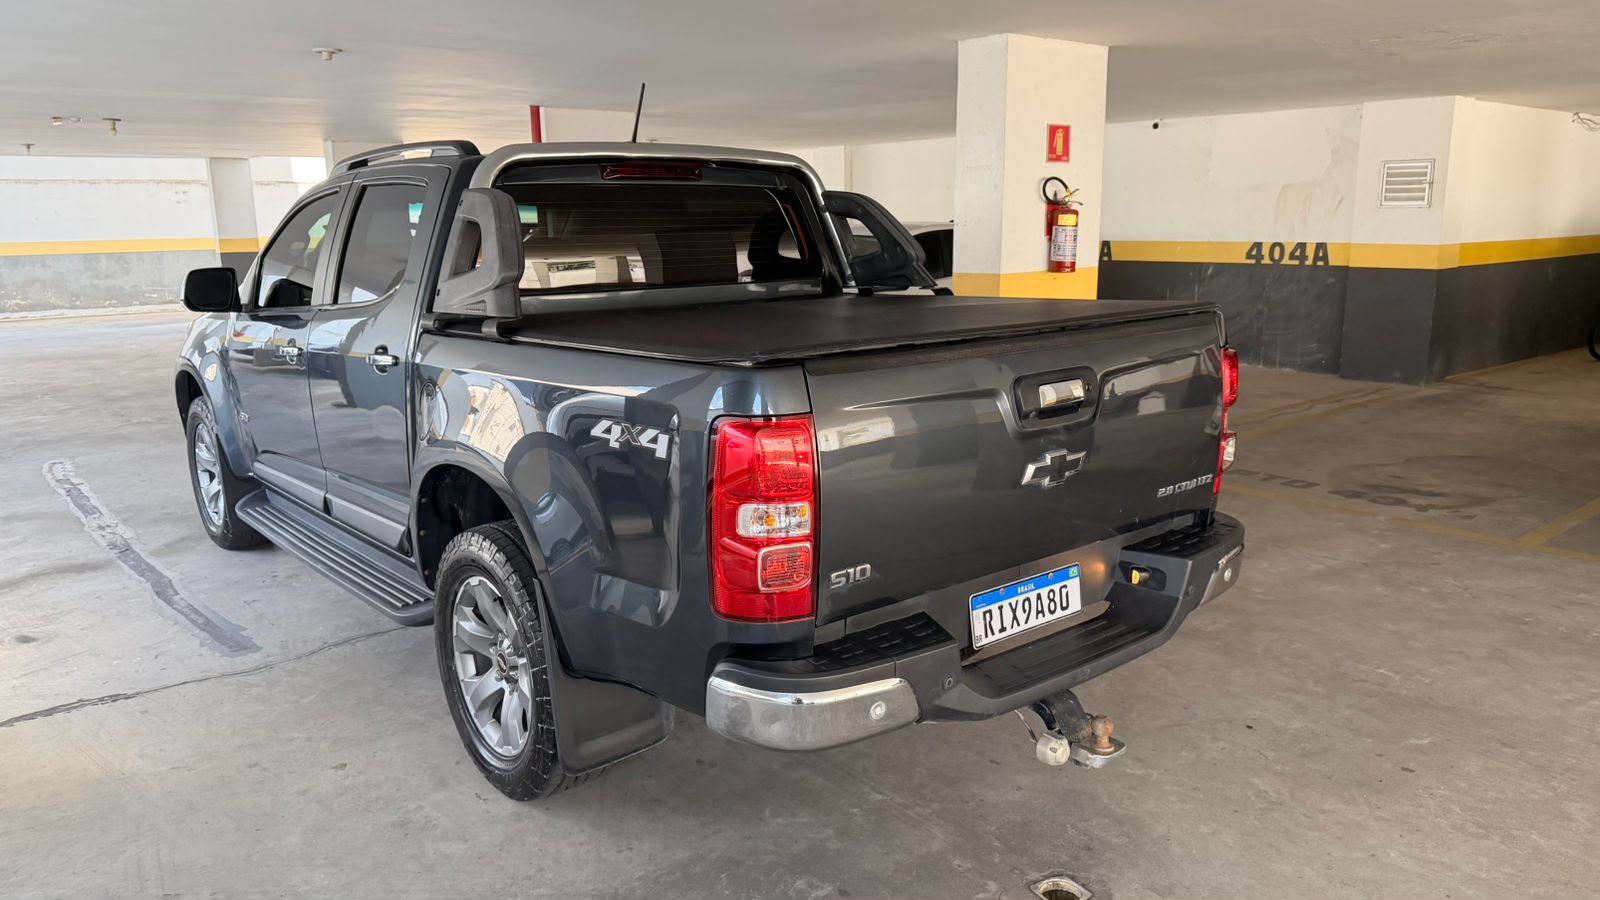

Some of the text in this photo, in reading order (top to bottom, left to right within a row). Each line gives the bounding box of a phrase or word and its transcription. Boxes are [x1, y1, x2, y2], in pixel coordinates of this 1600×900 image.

[1245, 241, 1330, 267] 404A
[830, 563, 872, 590] S10
[1017, 583, 1036, 594] BRASIL
